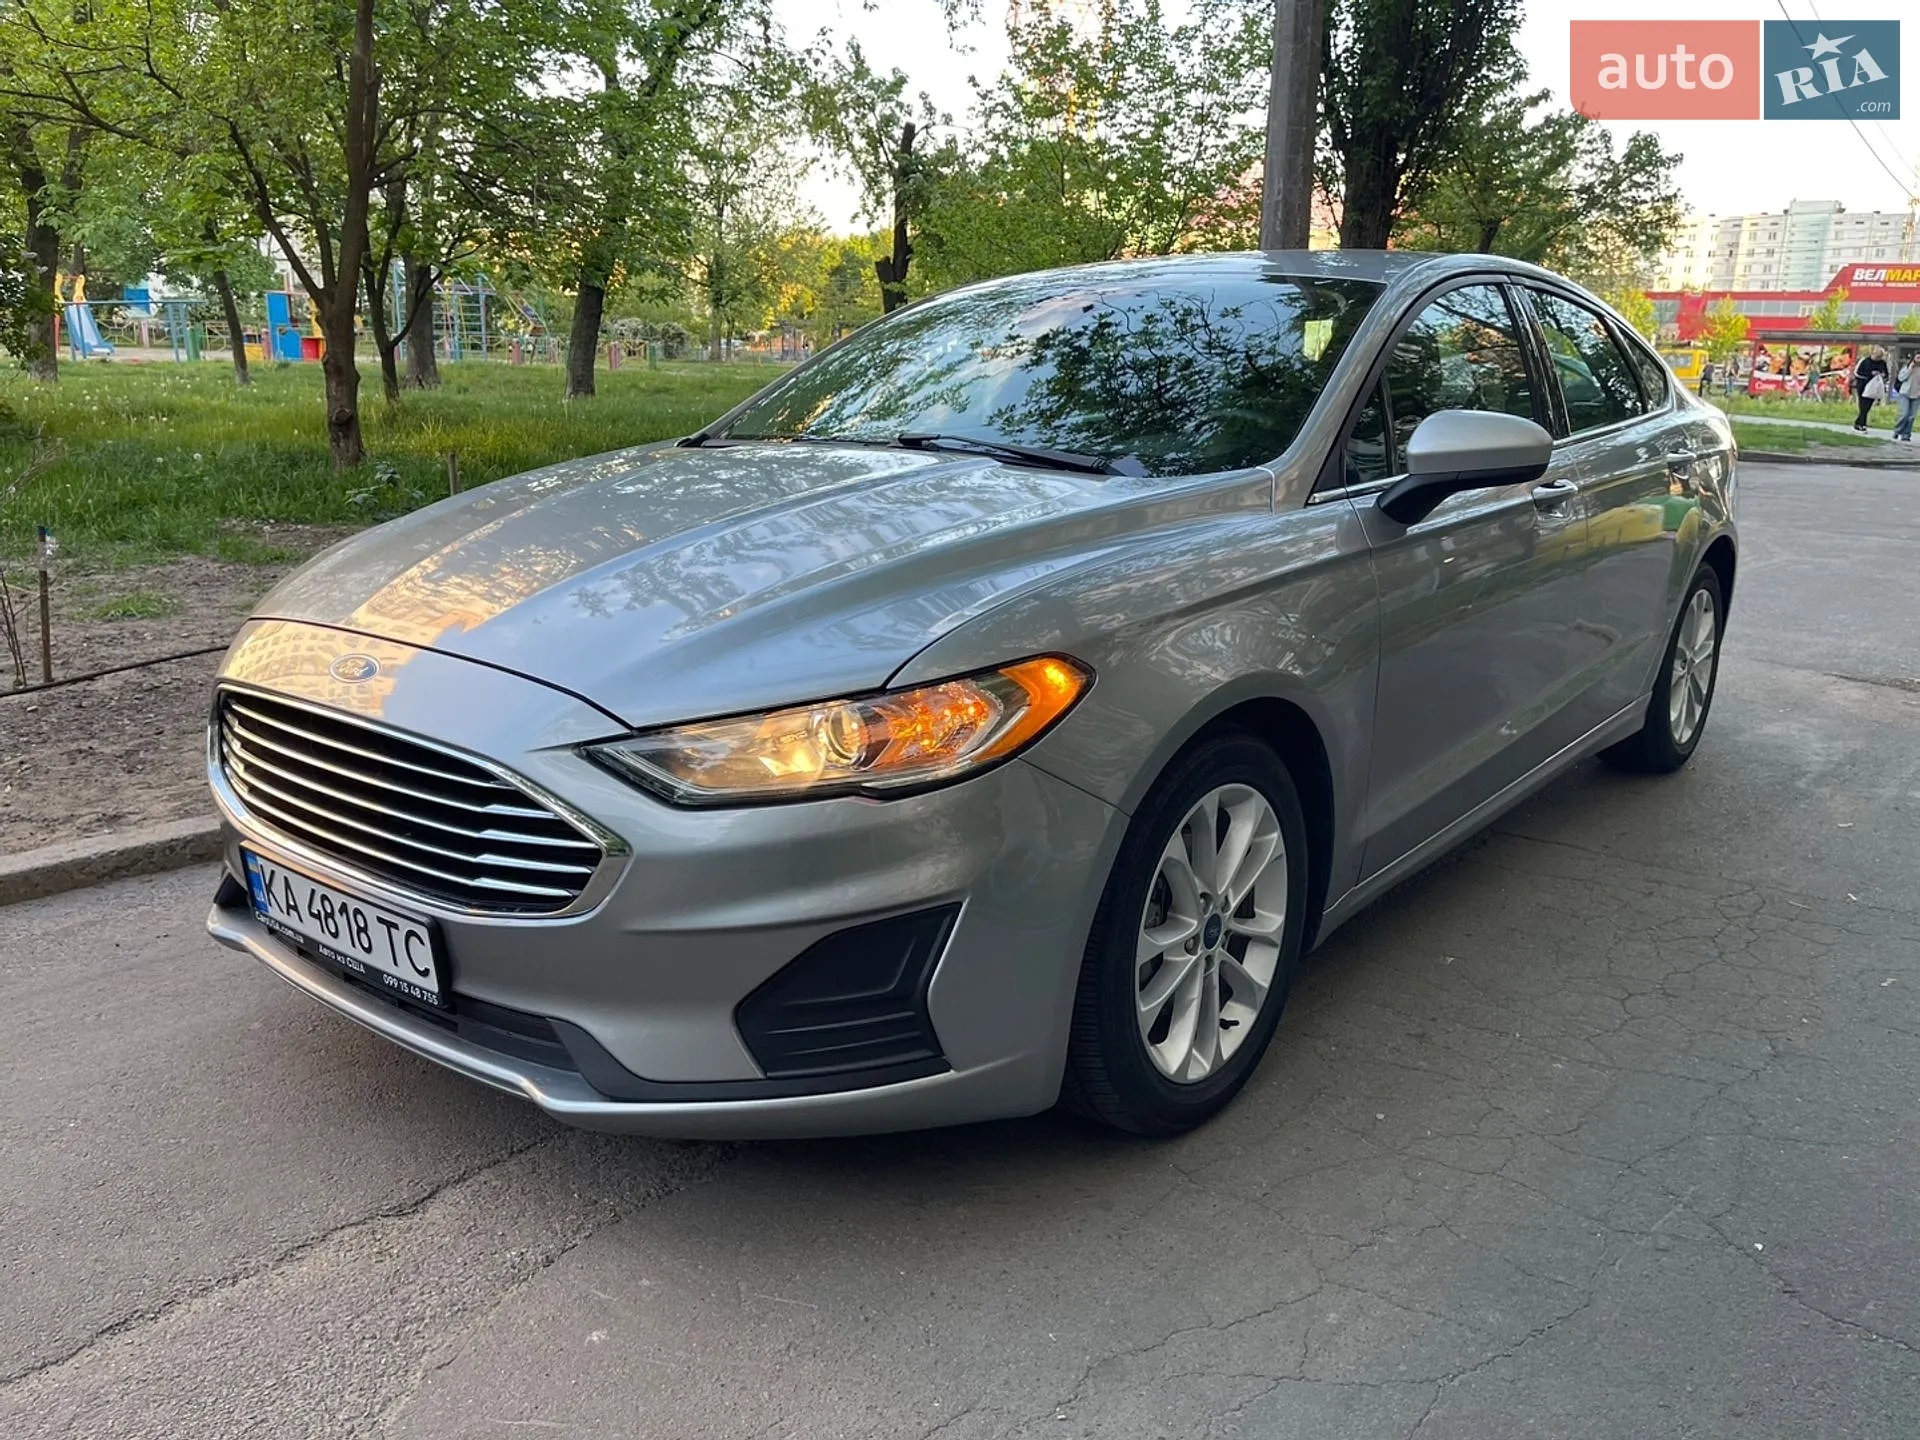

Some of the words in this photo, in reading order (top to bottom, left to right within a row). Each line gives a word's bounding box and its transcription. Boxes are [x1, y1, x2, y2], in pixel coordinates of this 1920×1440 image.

[259, 863, 303, 923] KA
[306, 888, 373, 955] 4818
[376, 916, 431, 977] TC
[382, 974, 398, 988] 099
